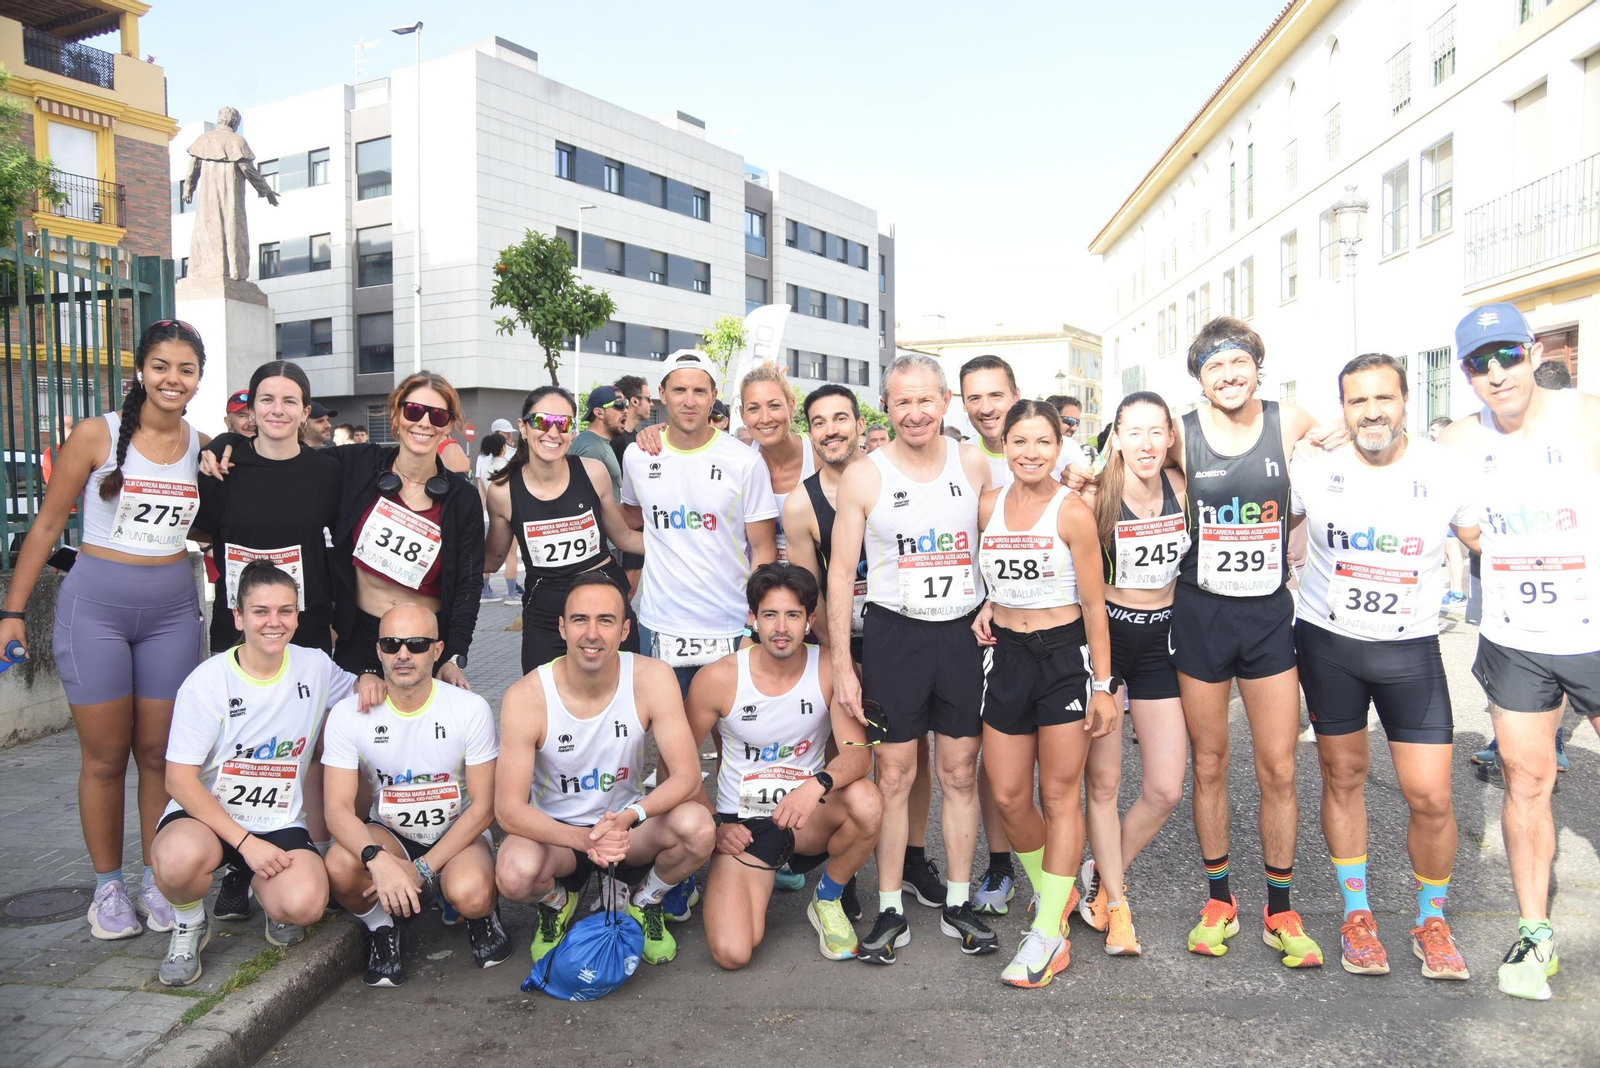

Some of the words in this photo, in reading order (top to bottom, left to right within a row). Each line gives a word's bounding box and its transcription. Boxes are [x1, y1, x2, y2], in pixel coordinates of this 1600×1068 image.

[1265, 458, 1279, 477] in
[134, 503, 183, 526] 275
[652, 505, 716, 531] indea
[1197, 497, 1278, 524] indea
[1486, 504, 1577, 534] indea
[1129, 523, 1150, 531] CARRERA
[375, 527, 422, 562] 318
[544, 539, 586, 562] 279
[896, 528, 969, 555] indea
[1327, 522, 1424, 556] indea
[1135, 542, 1178, 566] 245
[1217, 550, 1264, 572] 239
[995, 559, 1039, 580] 258
[924, 576, 952, 598] 17
[1520, 582, 1557, 604] 95
[1346, 588, 1398, 614] 382
[1106, 605, 1148, 624] NIKE
[234, 736, 306, 760] indea
[744, 740, 811, 762] indea
[235, 762, 256, 771] CARRERA
[376, 769, 449, 786] indea
[560, 767, 628, 793] indea
[227, 785, 278, 808] 244
[758, 788, 796, 804] 10
[398, 808, 445, 827] 243
